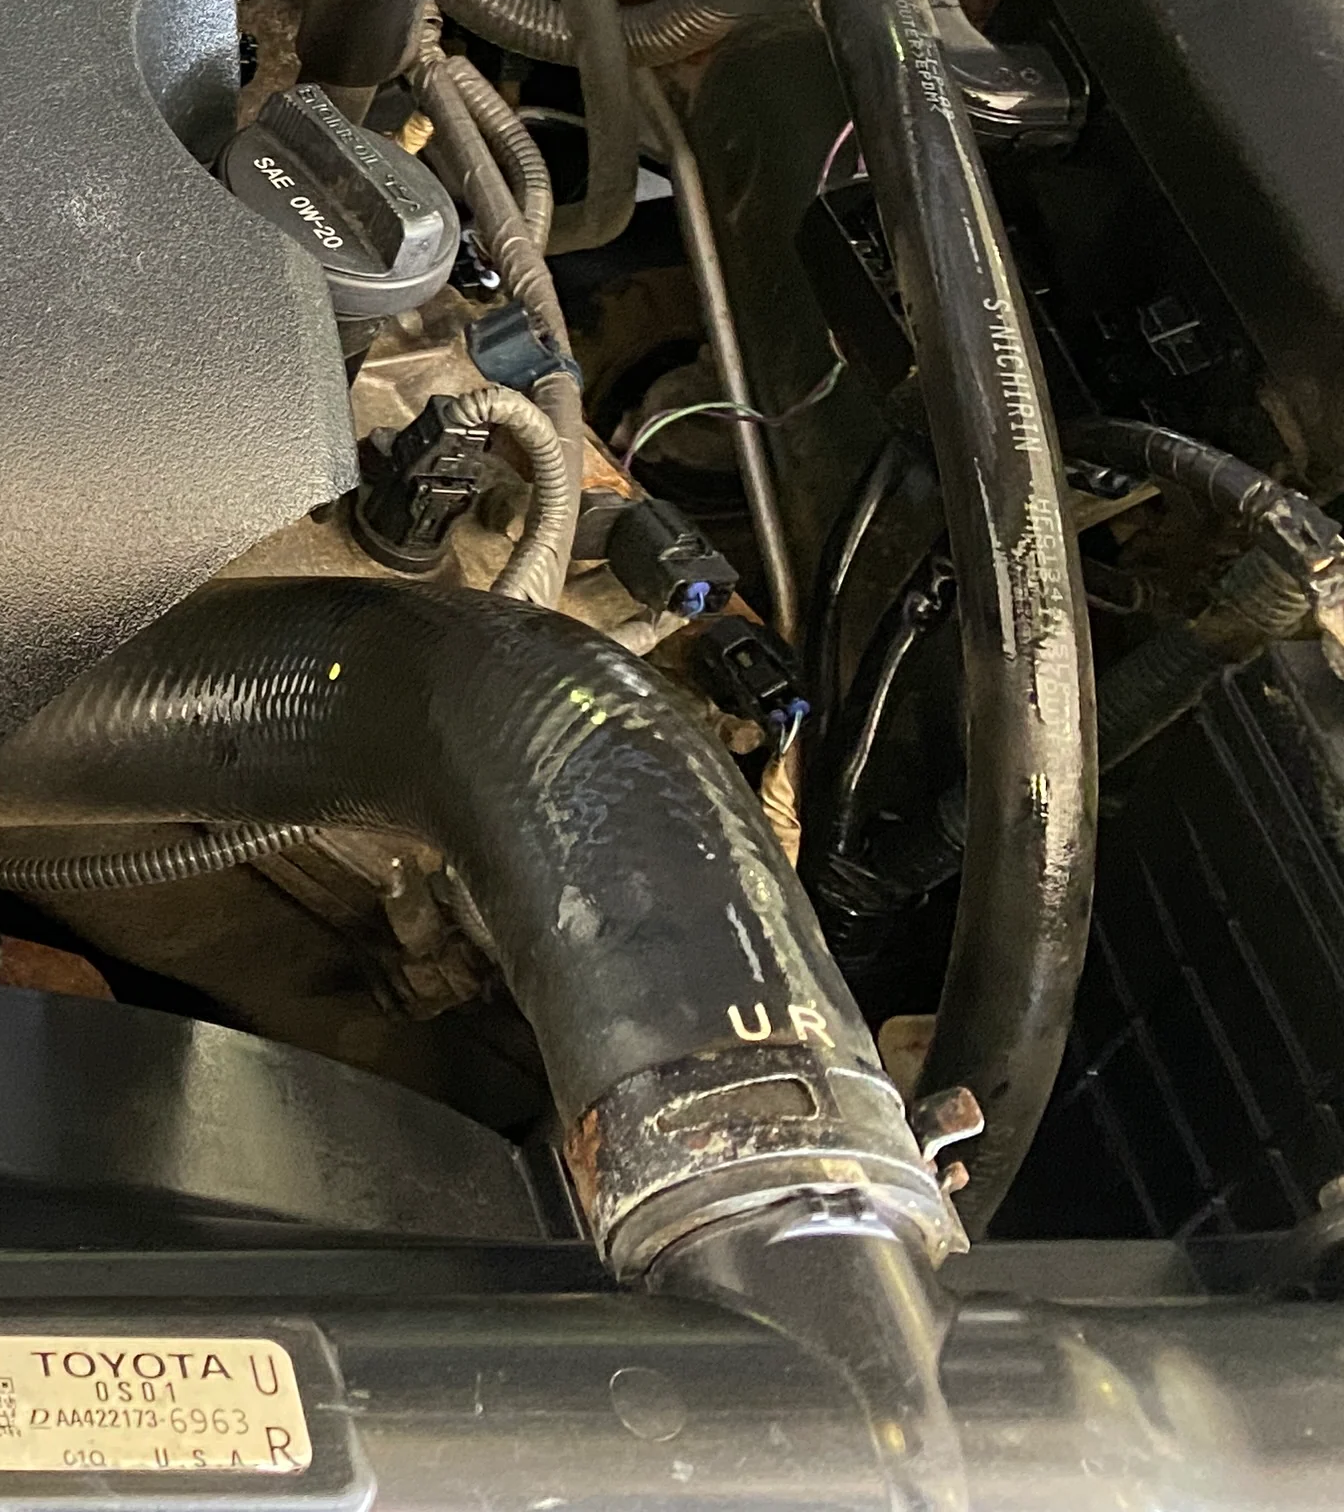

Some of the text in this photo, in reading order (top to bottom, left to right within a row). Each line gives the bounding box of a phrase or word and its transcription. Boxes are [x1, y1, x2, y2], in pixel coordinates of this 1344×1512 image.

[253, 156, 344, 249] SAE 0W-20
[31, 1351, 279, 1396] TOYOTA U
[265, 1426, 301, 1467] R
